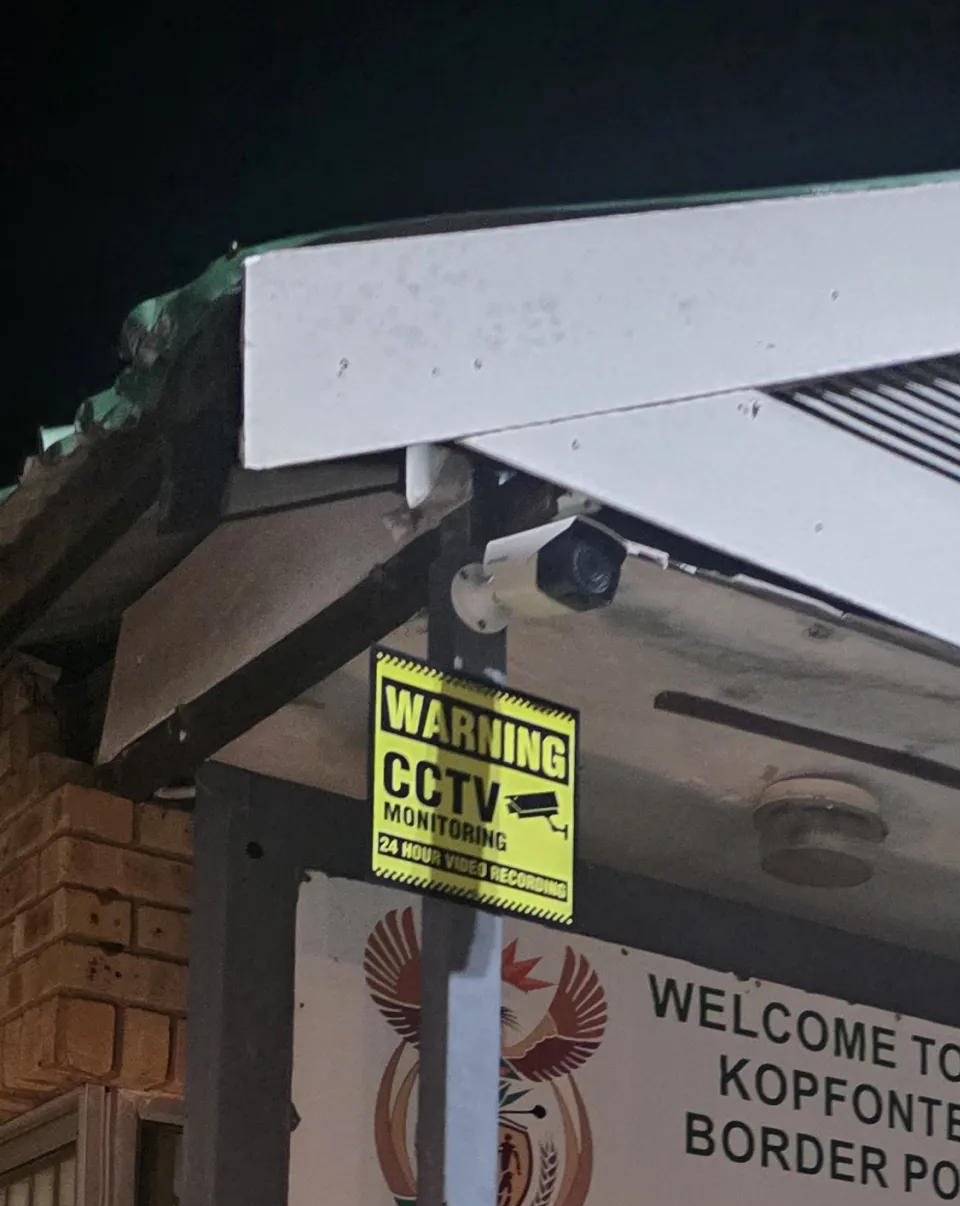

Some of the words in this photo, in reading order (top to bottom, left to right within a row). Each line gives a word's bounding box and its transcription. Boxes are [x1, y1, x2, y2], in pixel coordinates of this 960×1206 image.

[385, 684, 567, 779] WARNING
[383, 751, 500, 823] CCTV
[384, 801, 507, 851] MONITORING
[379, 836, 399, 855] 24
[402, 841, 442, 865] HOUR
[445, 855, 488, 878] VIDEO
[490, 864, 568, 899] RECORDING
[648, 973, 898, 1069] WELCOME
[685, 1111, 889, 1189] BORDER
